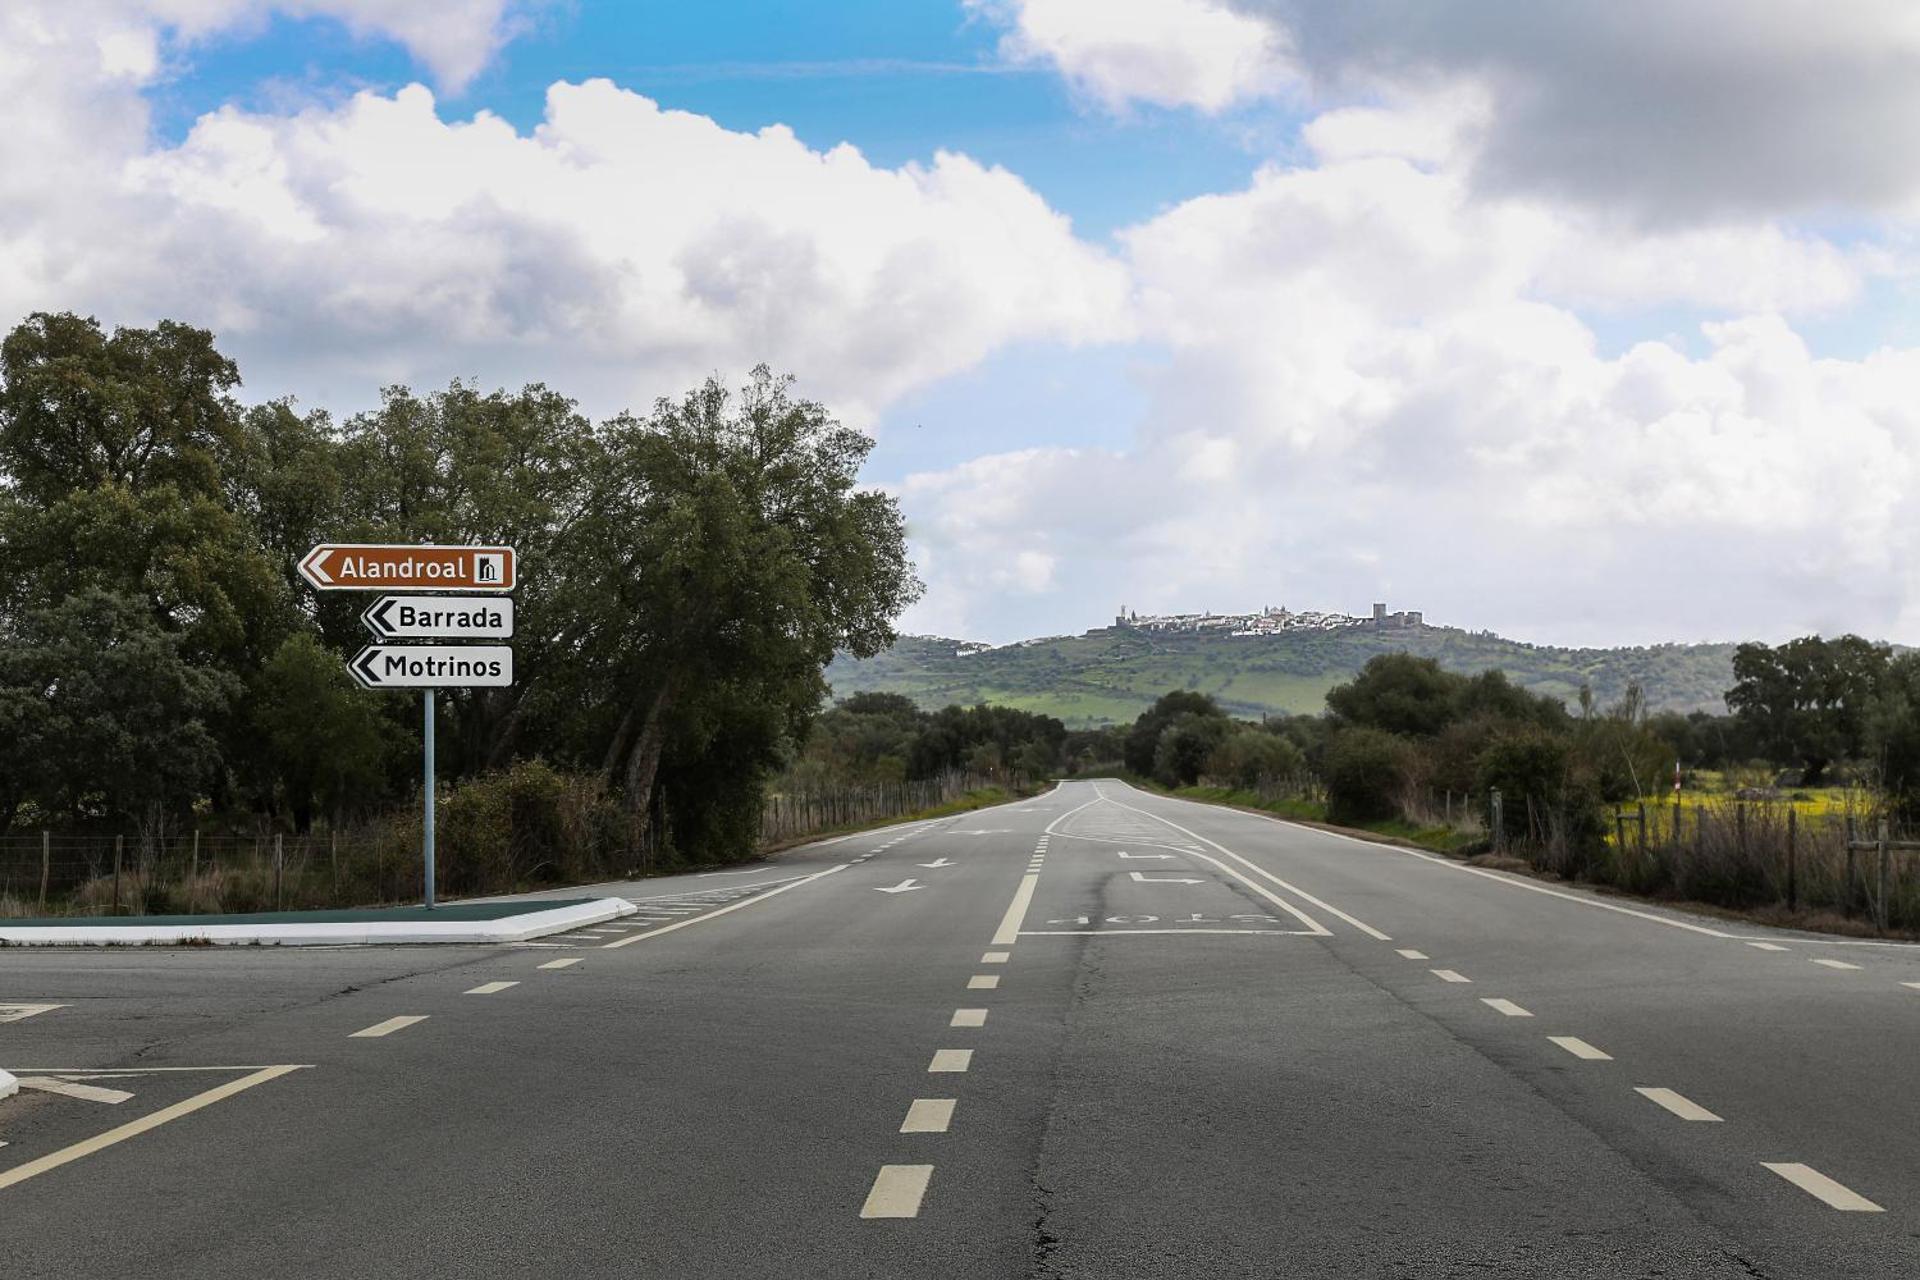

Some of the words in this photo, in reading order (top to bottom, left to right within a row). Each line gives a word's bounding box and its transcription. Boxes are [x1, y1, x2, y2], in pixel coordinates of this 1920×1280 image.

[339, 556, 467, 579] Alandroal
[400, 606, 503, 628] Barrada
[384, 655, 502, 677] Motrinos
